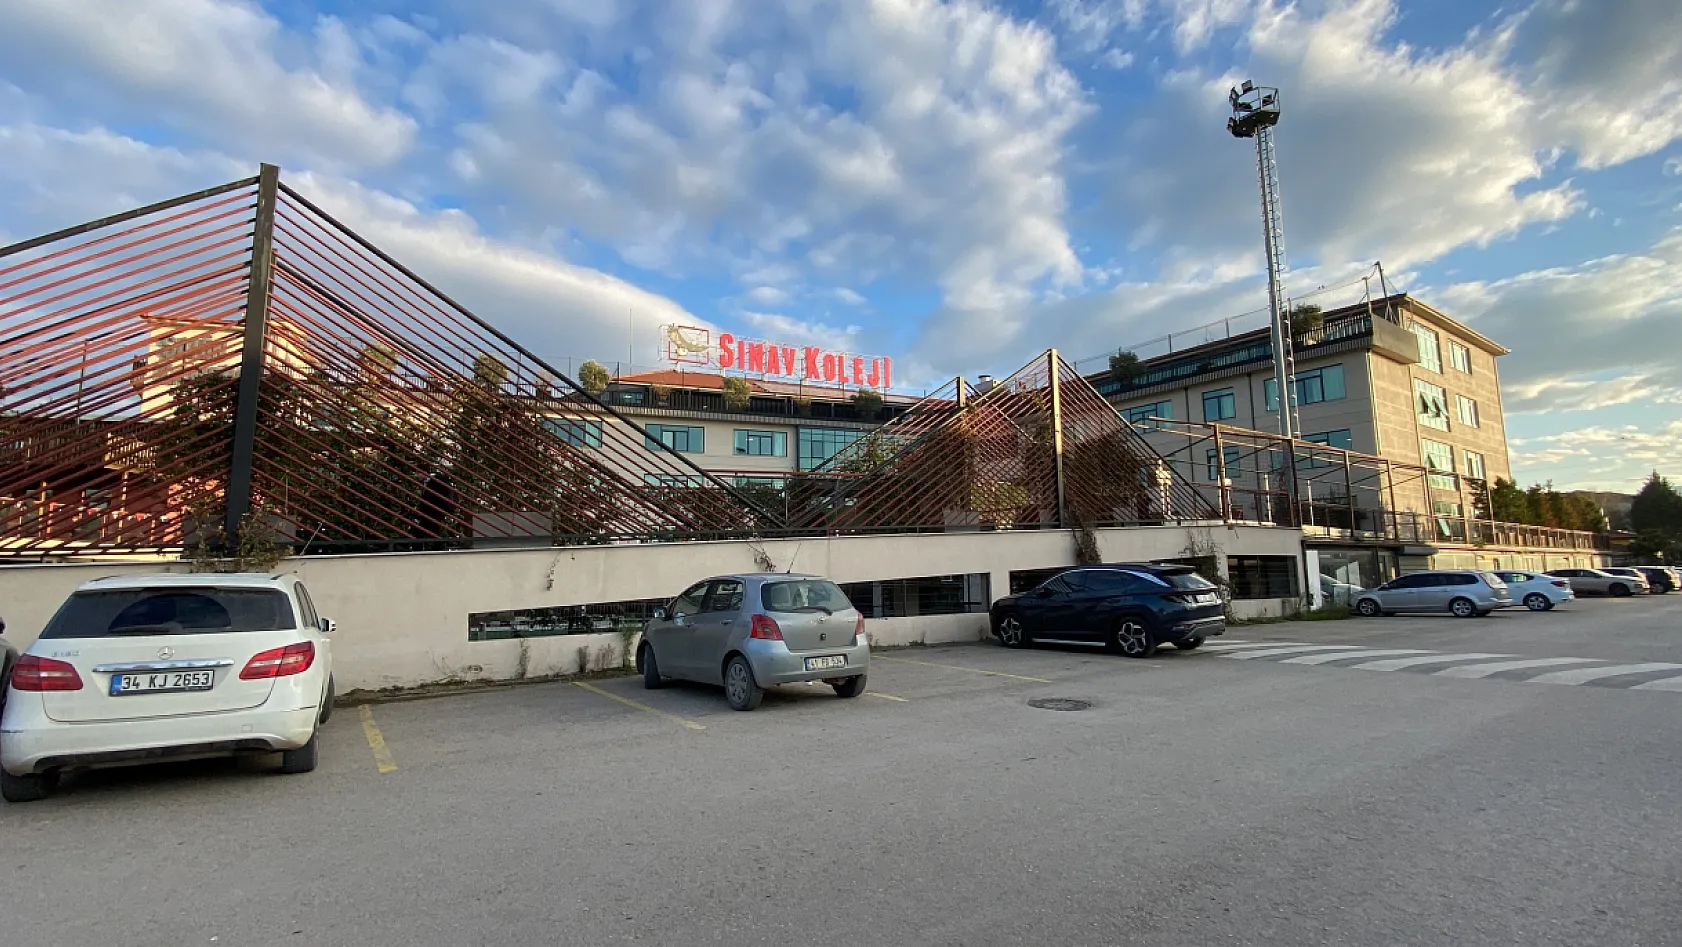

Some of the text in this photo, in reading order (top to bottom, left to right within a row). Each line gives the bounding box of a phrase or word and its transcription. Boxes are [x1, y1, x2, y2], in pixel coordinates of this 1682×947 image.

[719, 333, 795, 376] SINAV
[122, 673, 210, 690] 34 KJ 2653
